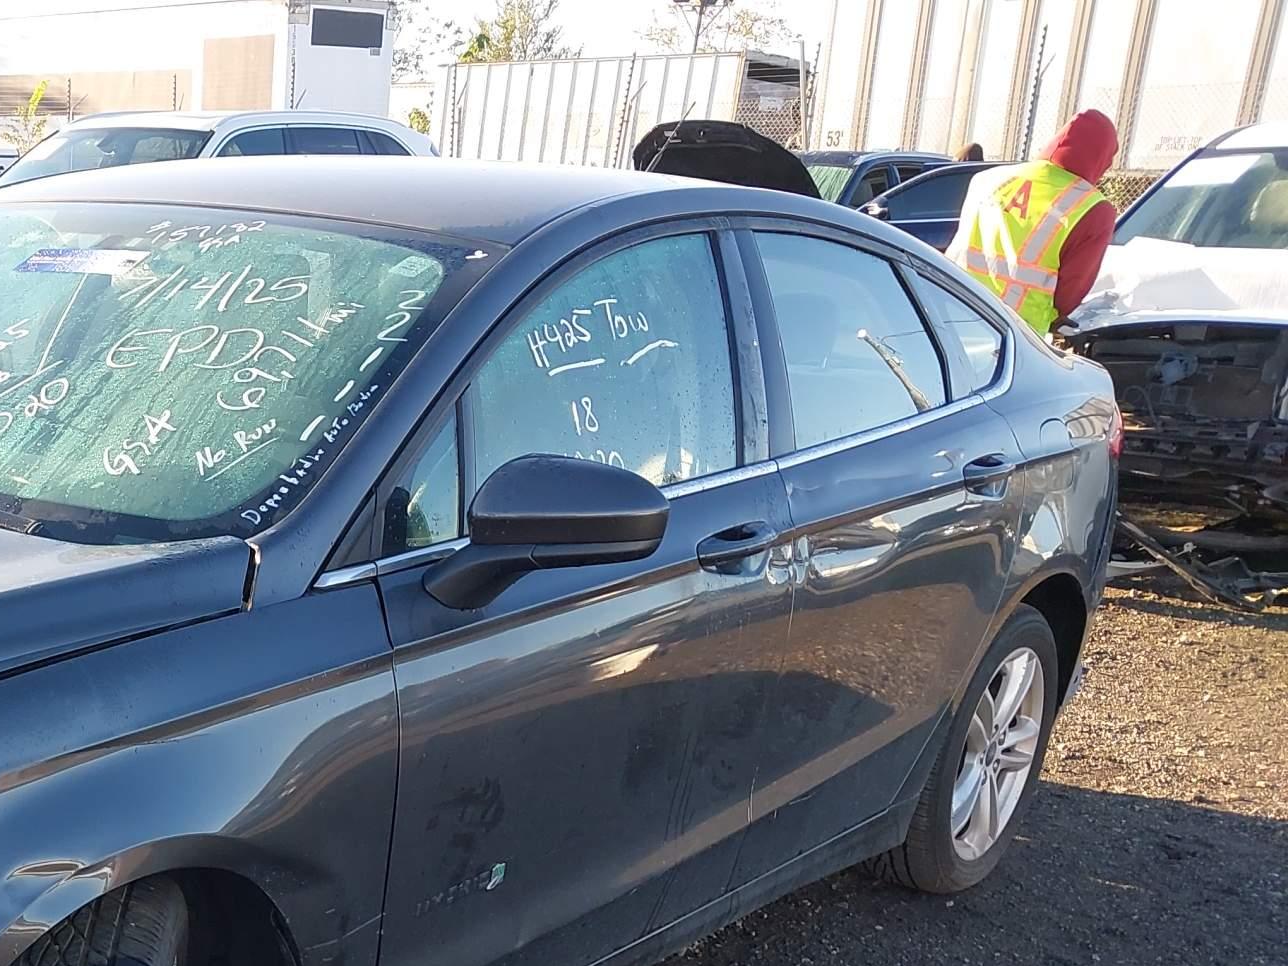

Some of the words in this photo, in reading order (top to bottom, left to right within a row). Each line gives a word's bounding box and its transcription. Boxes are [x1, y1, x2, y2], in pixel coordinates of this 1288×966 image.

[117, 264, 312, 312] 7/14/25
[527, 309, 592, 368] H425
[571, 396, 599, 436] 18
